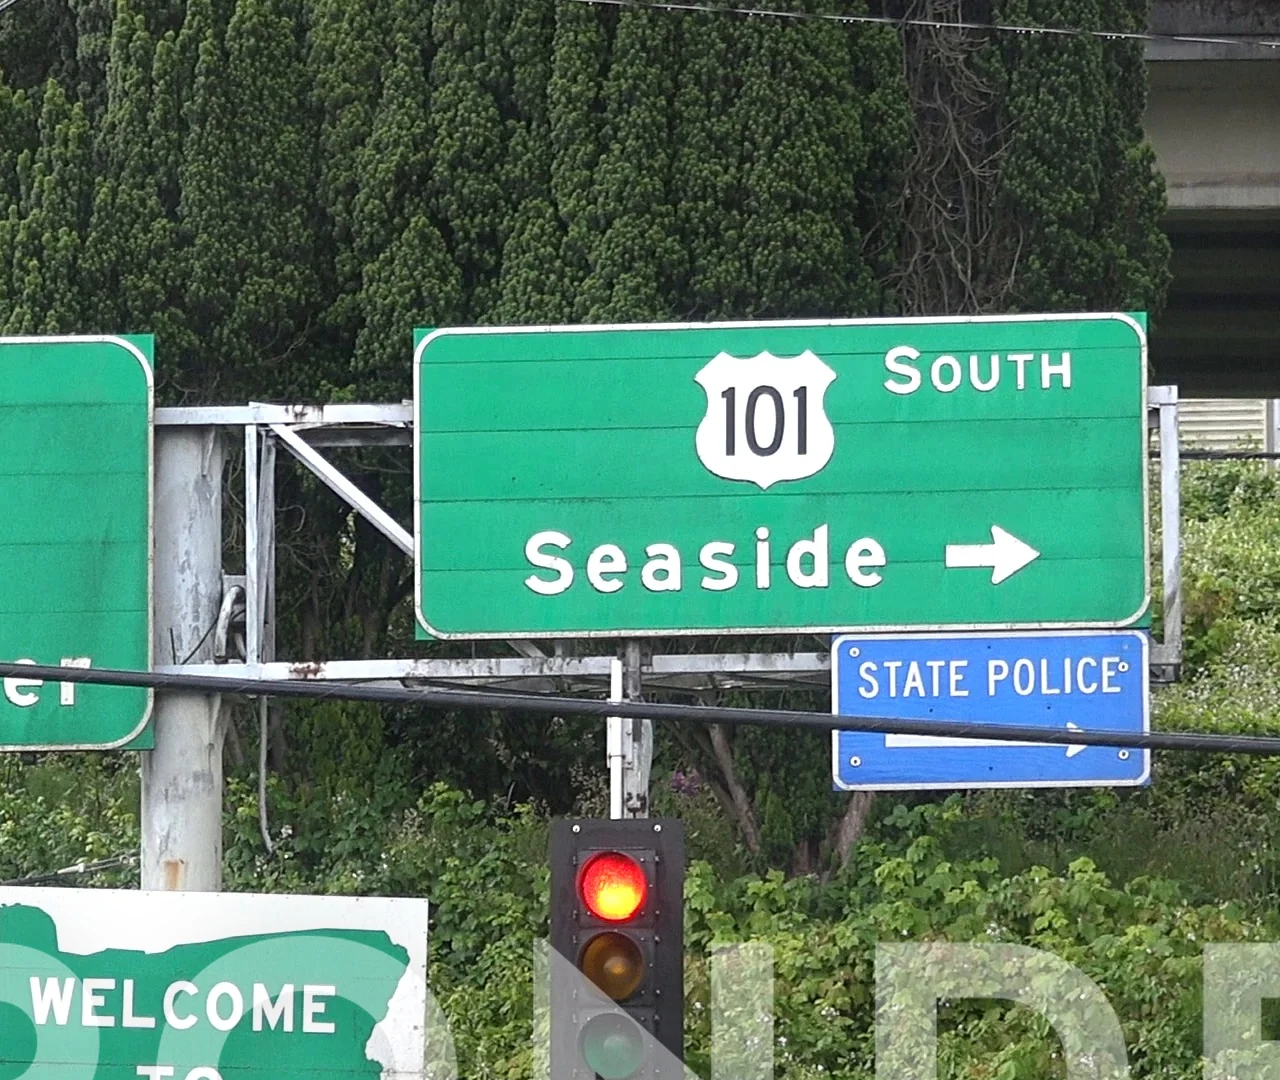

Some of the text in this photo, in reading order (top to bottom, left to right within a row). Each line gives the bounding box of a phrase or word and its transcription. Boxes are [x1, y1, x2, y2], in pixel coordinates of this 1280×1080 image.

[884, 345, 1072, 395] SOUTH
[720, 385, 808, 457] 101
[524, 523, 888, 596] Seaside
[858, 656, 1121, 699] STATE POLICE
[29, 976, 337, 1034] WELCOME
